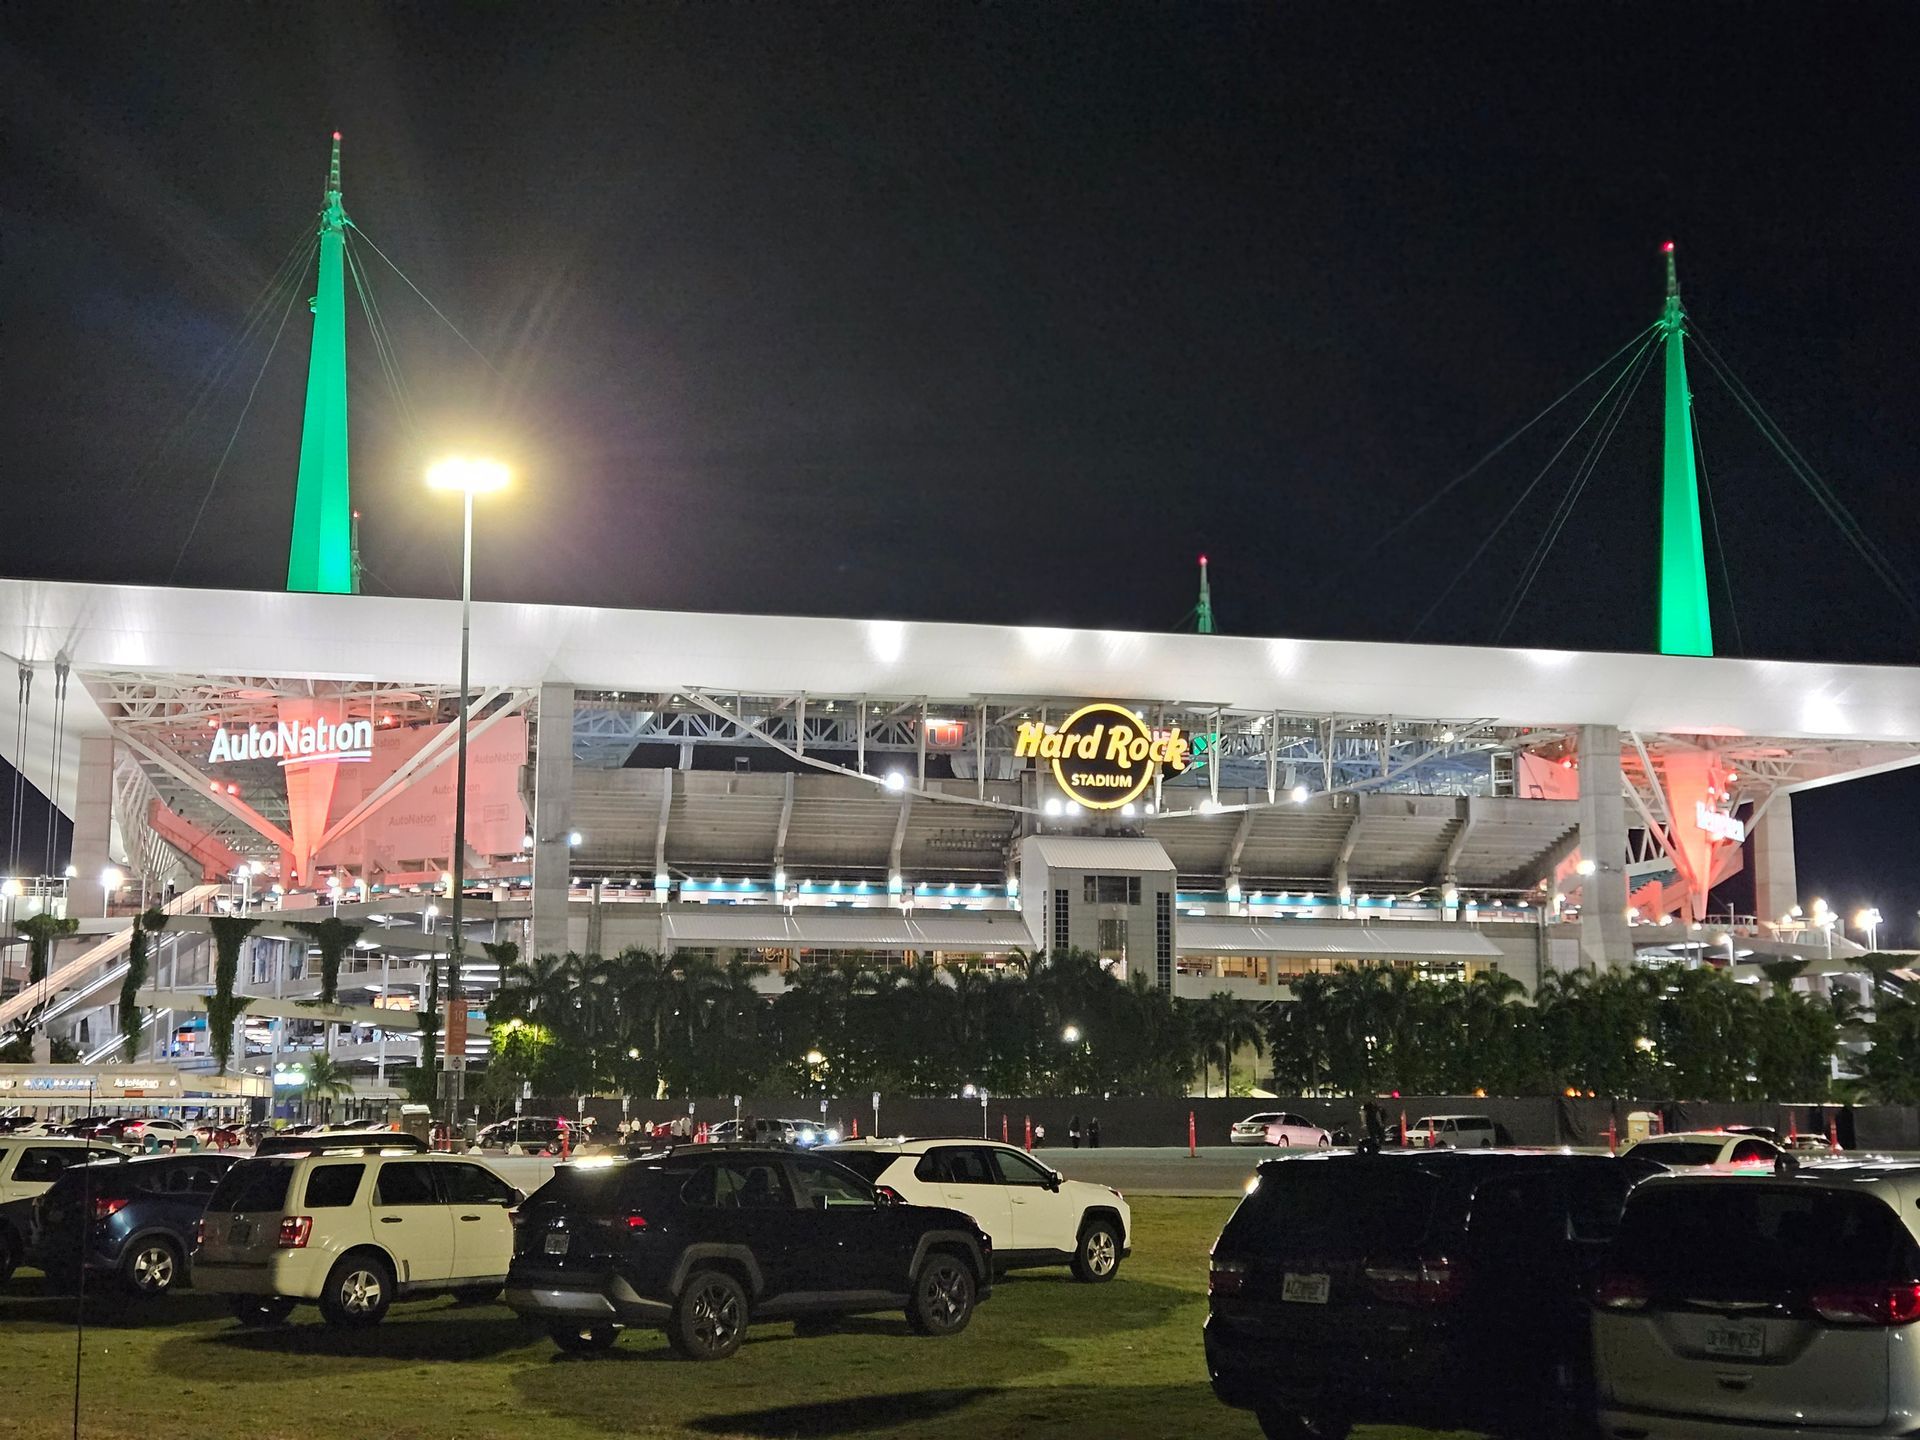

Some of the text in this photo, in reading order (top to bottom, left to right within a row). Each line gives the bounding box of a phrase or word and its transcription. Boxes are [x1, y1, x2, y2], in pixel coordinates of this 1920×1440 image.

[208, 716, 372, 763] AutoNation
[1015, 721, 1188, 771] Hard Rock
[473, 749, 524, 765] AutoNation
[1071, 773, 1133, 788] STADIUM
[388, 814, 438, 827] AutoNation
